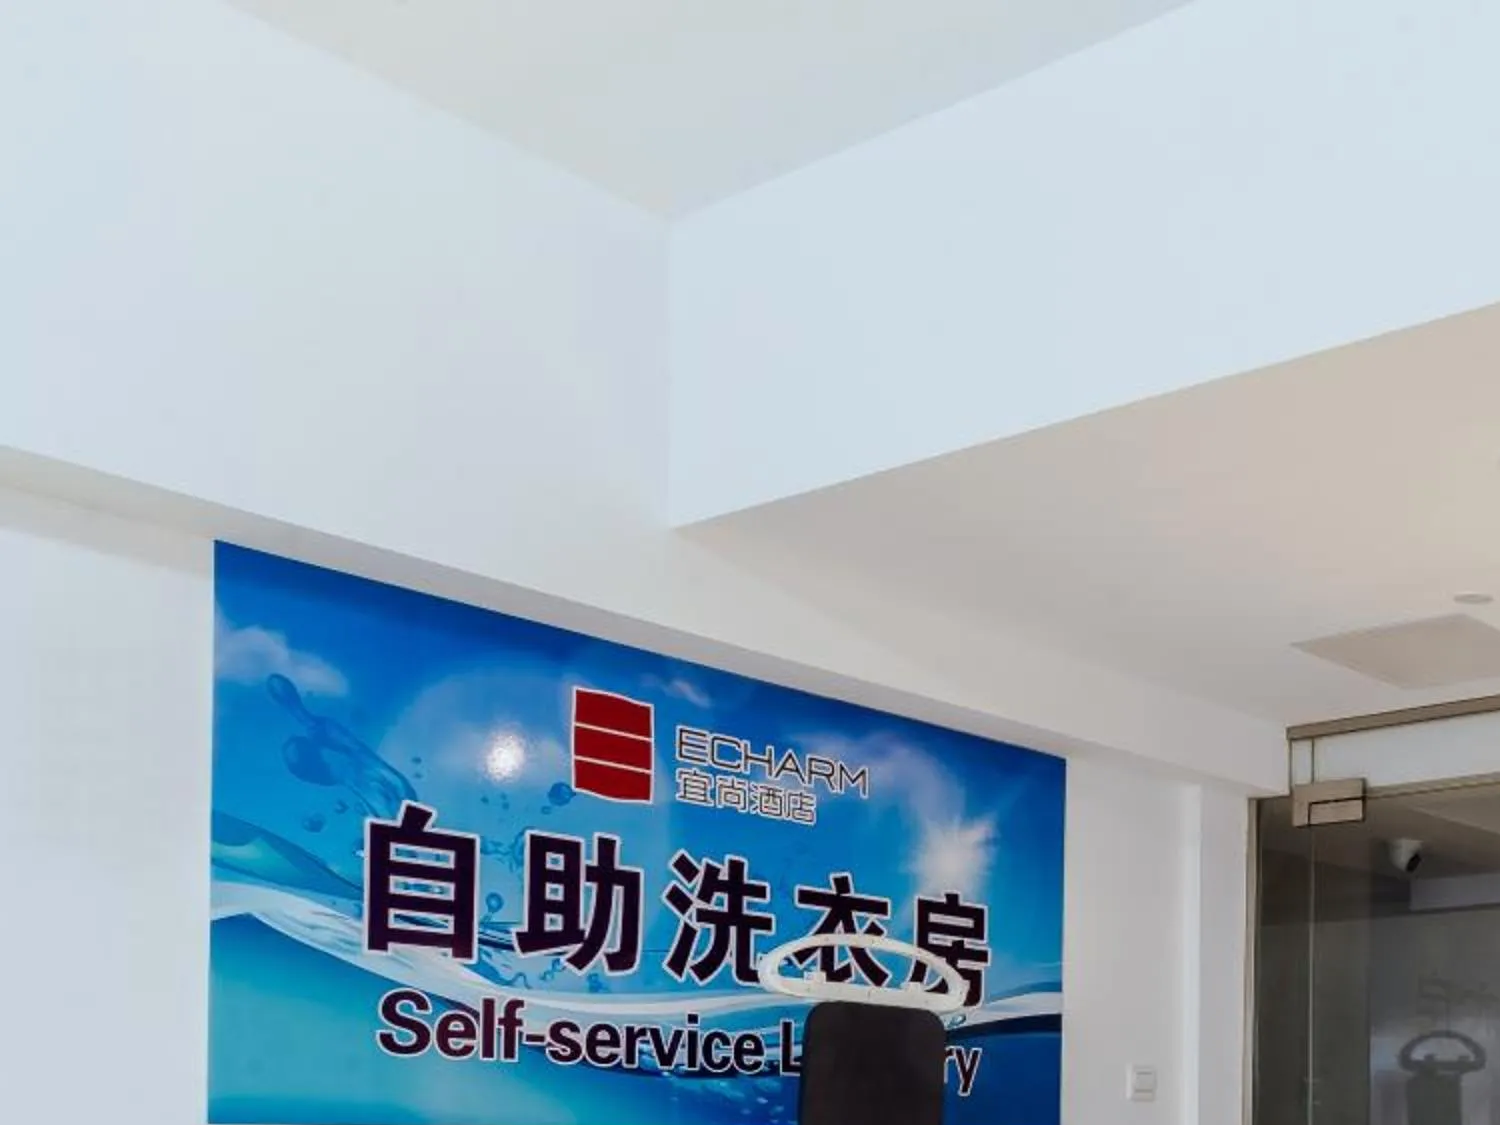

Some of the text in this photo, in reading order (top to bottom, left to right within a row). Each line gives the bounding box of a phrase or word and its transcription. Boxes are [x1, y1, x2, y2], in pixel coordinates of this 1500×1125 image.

[675, 725, 869, 799] ECHARM
[676, 767, 817, 826] 宜尚酒店
[364, 801, 991, 1007] 自助洗衣房
[377, 988, 766, 1073] Self-service
